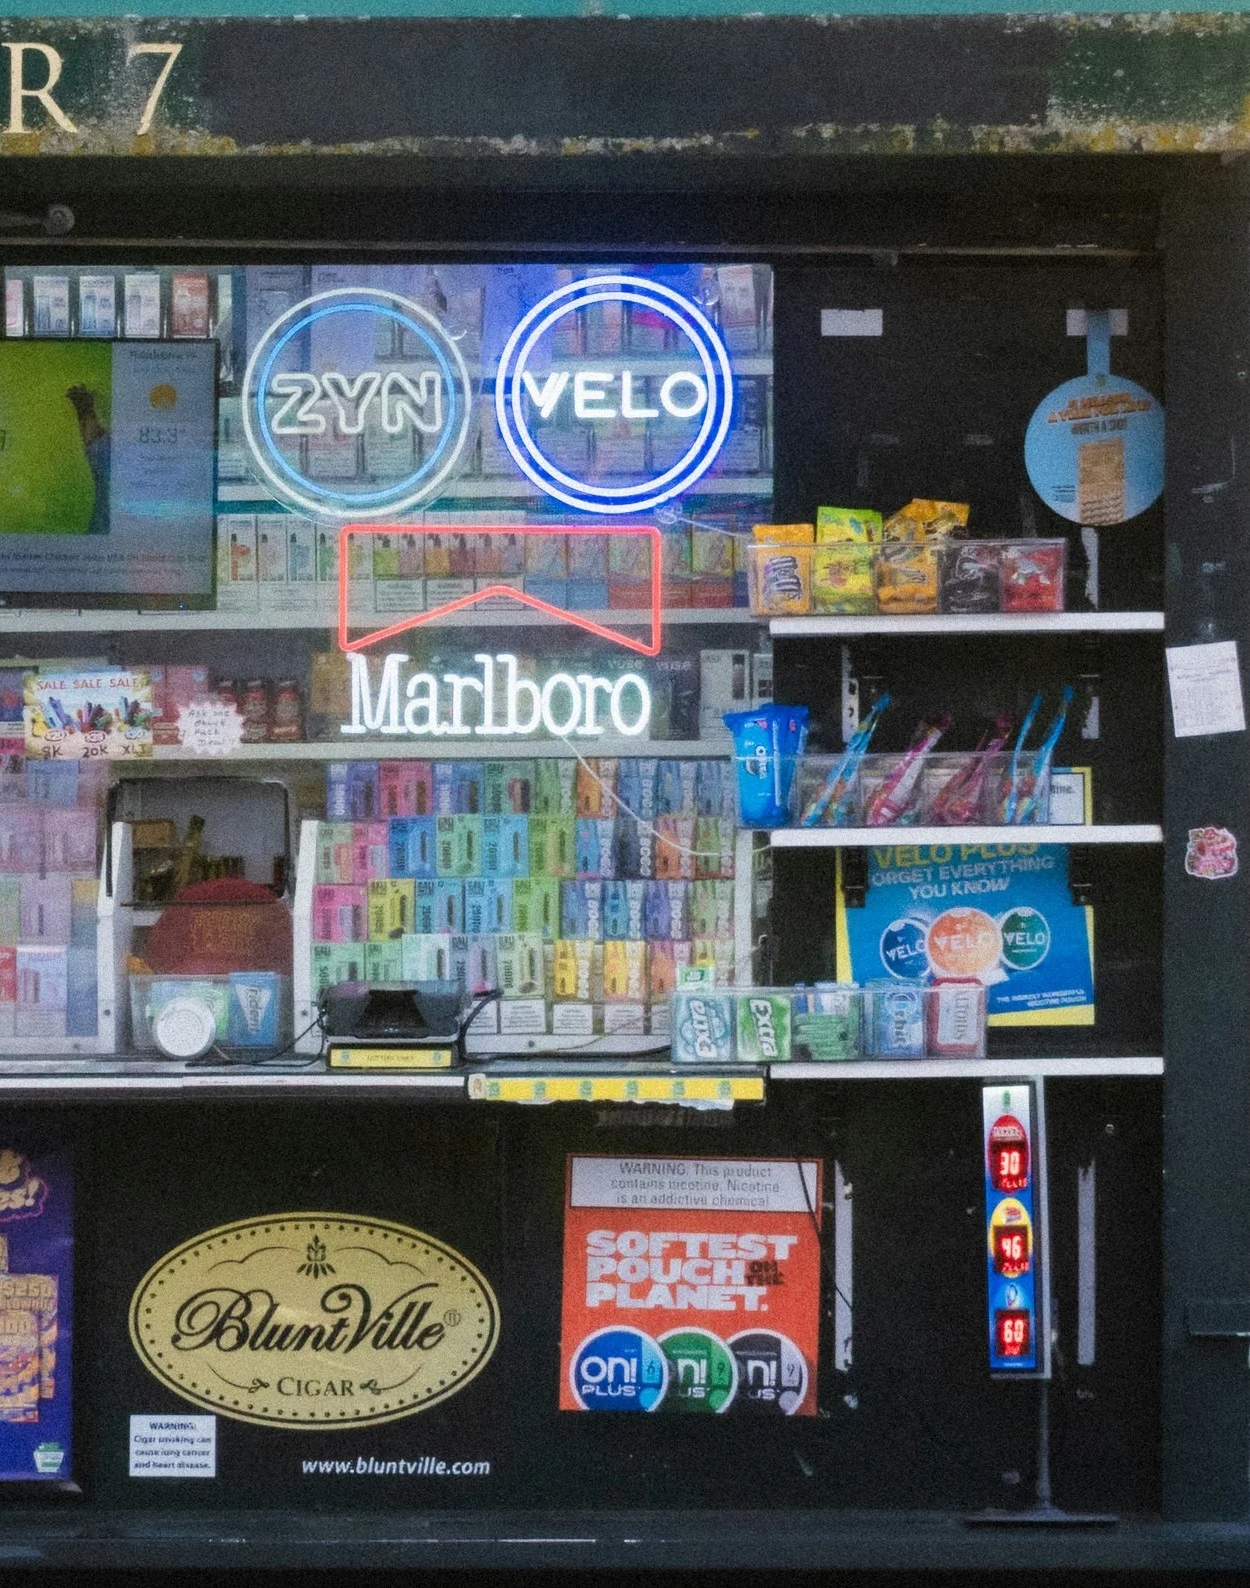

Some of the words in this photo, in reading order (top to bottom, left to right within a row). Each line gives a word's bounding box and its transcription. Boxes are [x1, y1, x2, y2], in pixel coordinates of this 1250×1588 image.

[127, 43, 183, 136] 7
[270, 371, 443, 434] ZYN
[522, 370, 708, 419] VELO
[37, 680, 67, 690] SALE
[73, 679, 102, 690] SALE
[109, 678, 140, 689] SALE
[340, 651, 652, 737] Marlboro
[871, 844, 952, 869] VELO
[870, 868, 934, 888] ORGET
[937, 856, 1056, 880] EVERYTHING
[908, 882, 947, 901] YOU
[950, 876, 1012, 897] KNOW
[885, 939, 927, 963] VELO
[1003, 931, 1046, 947] VELO
[692, 1163, 719, 1177] This
[723, 1165, 772, 1181] product
[999, 1151, 1021, 1176] 30
[610, 1178, 665, 1190] contains
[726, 1180, 780, 1193] Nicotine
[616, 1193, 628, 1203] is
[630, 1194, 647, 1204] an
[649, 1194, 708, 1206] addictive
[586, 1229, 798, 1261] SOFTEST
[586, 1255, 747, 1287] POUCH
[586, 1282, 769, 1312] PLANET.
[170, 1282, 446, 1354] BluntVille
[276, 1376, 356, 1397] CIGAR
[580, 1385, 638, 1397] PLUS
[133, 1435, 157, 1444] Cigar
[158, 1435, 195, 1445] smoking
[152, 1460, 175, 1469] heart
[161, 1449, 181, 1458] lung
[301, 1456, 492, 1476] www.bluntville.com
